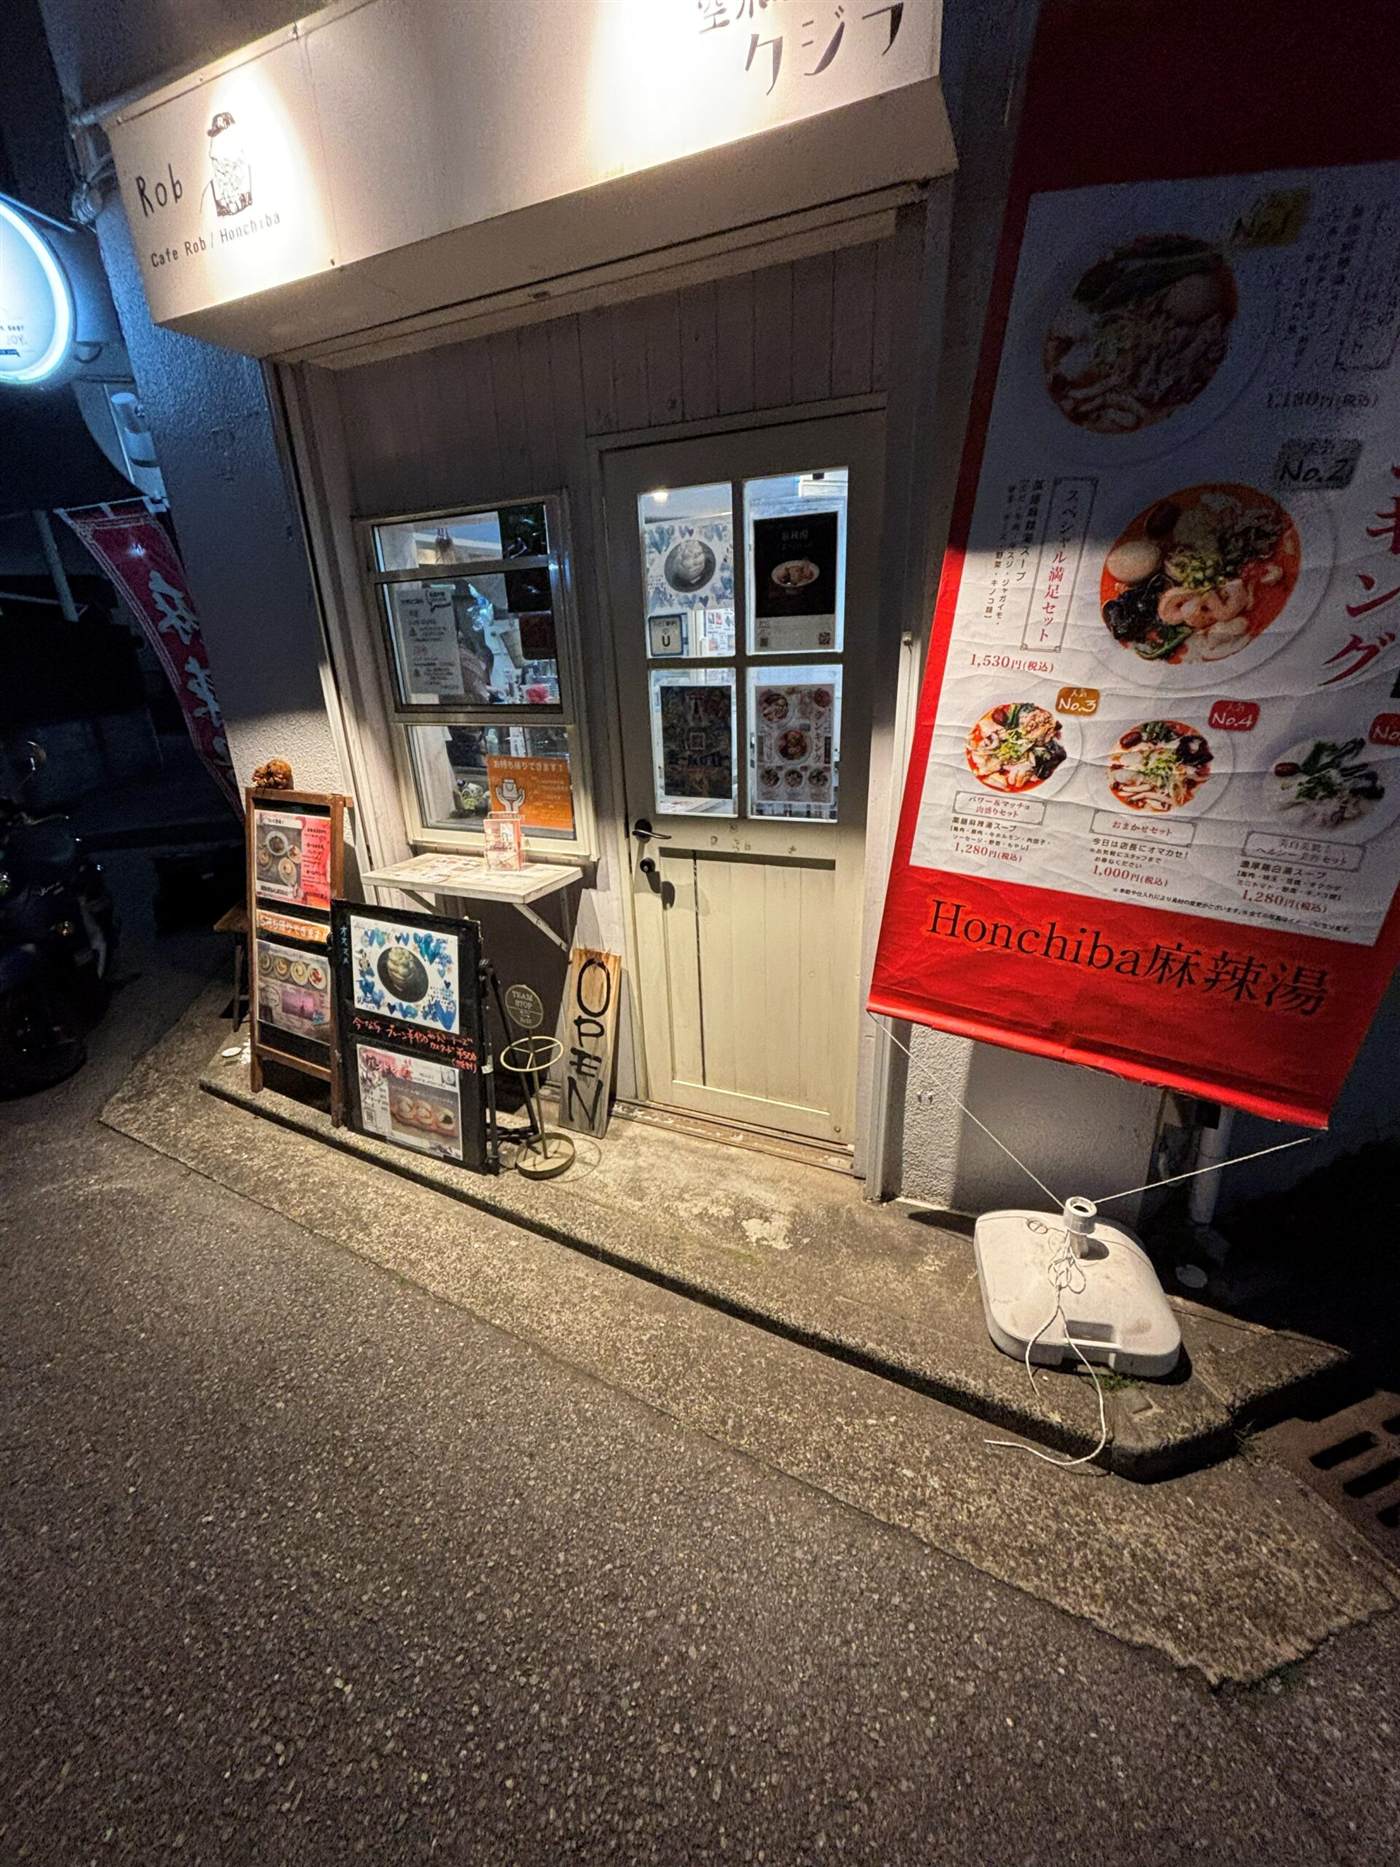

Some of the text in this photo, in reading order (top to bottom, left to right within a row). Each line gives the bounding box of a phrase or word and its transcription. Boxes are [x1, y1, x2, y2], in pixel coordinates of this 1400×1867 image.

[135, 163, 184, 218] Rob
[151, 248, 180, 269] Cafe
[184, 237, 207, 258] Rob
[219, 211, 282, 244] Honchiba
[1279, 458, 1353, 484] No.2
[1038, 488, 1080, 643] スペシャル満足セット
[968, 652, 1055, 674] 1,530円(税込)
[1058, 697, 1098, 712] No.3
[1211, 712, 1253, 728] No.4
[1372, 724, 1400, 741] No
[975, 805, 1020, 818] 肉盛りセット
[1111, 820, 1173, 837] おまかせセット
[953, 842, 1024, 864] 1,280円(税込)
[1092, 864, 1169, 888] 1,000円(税込)
[1242, 889, 1328, 914] 1,280円(税込)
[926, 899, 1330, 1017] Honchiba麻辣湯
[567, 957, 612, 1131] OPEN
